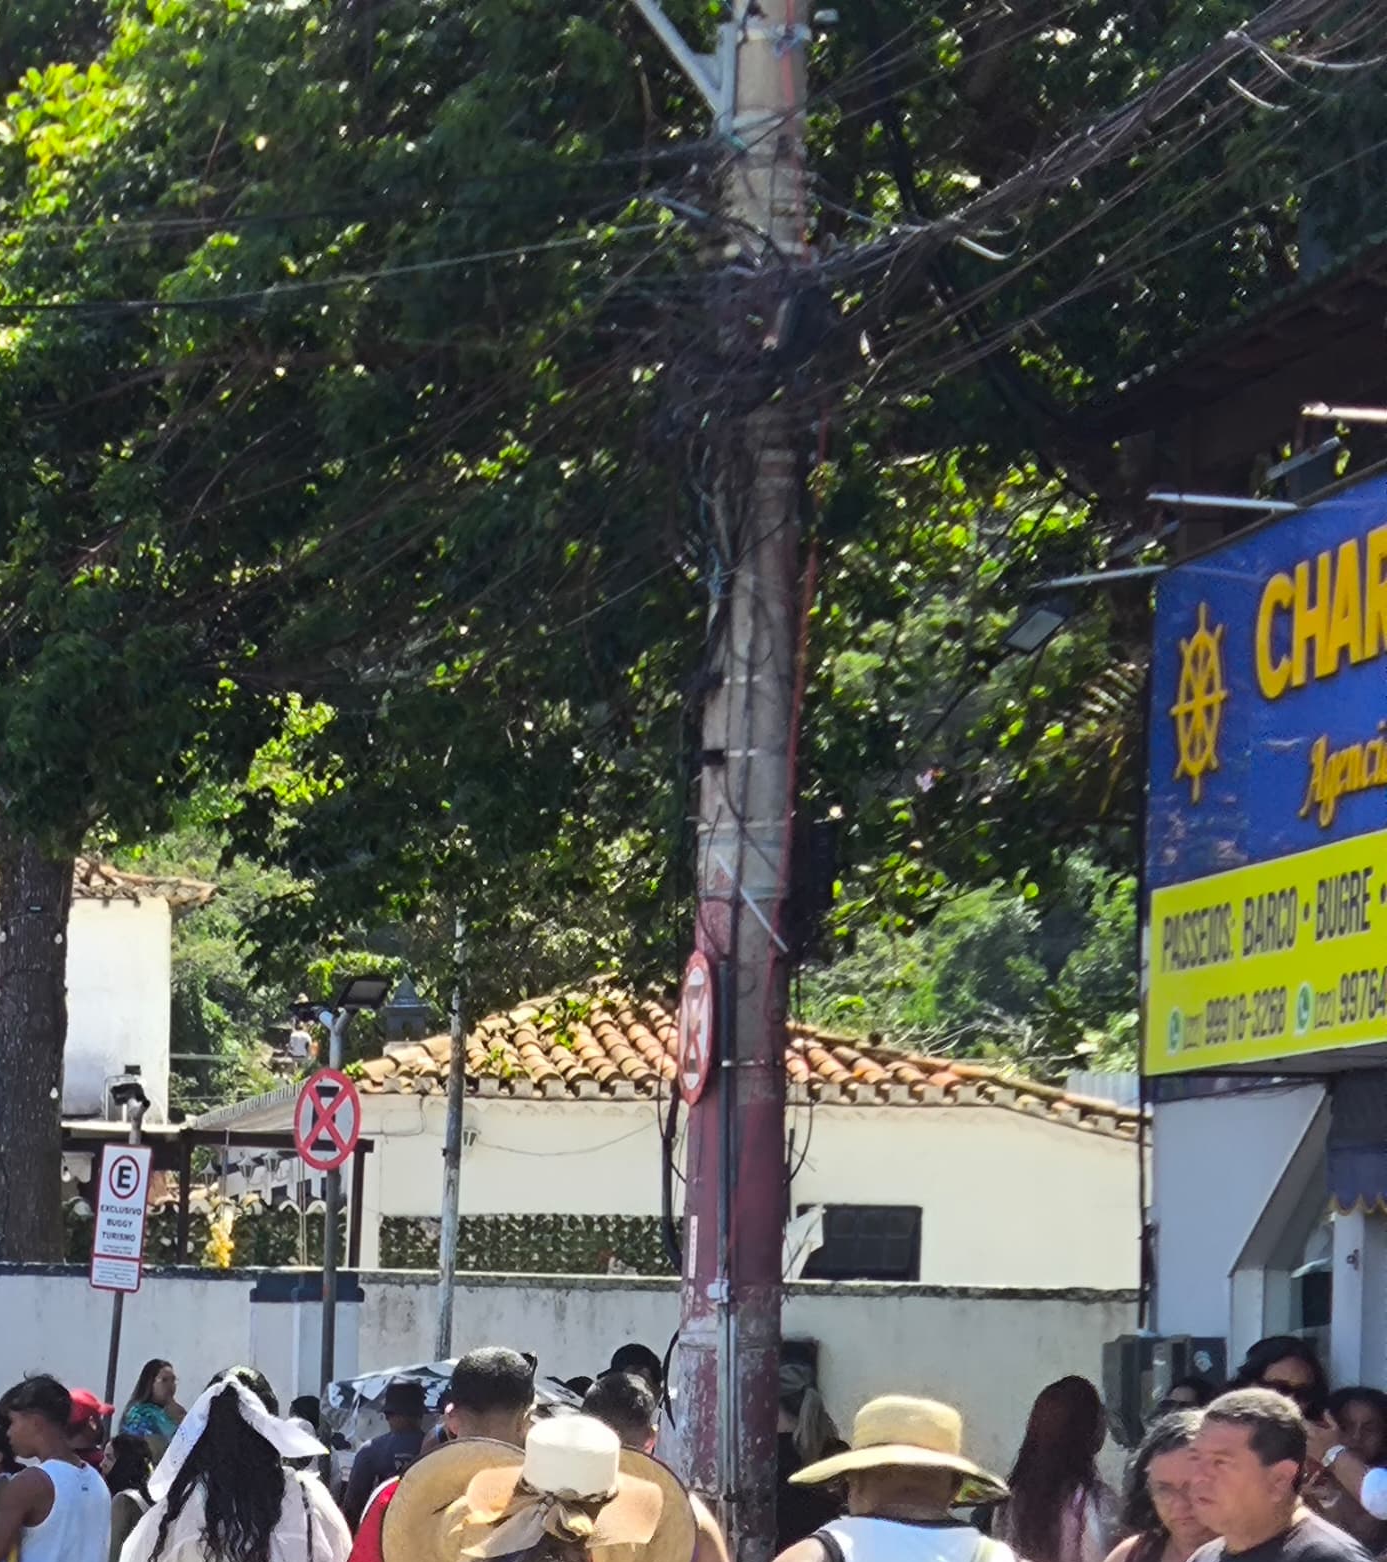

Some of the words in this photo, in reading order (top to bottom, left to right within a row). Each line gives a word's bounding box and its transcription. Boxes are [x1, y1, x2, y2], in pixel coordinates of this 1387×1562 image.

[1242, 886, 1298, 957] BARCO
[1315, 866, 1374, 942] BUGRE
[116, 1165, 132, 1189] E
[100, 1203, 142, 1216] EXCLUSIVO
[106, 1218, 133, 1228] BUGGY
[102, 1231, 136, 1243] TURISMO
